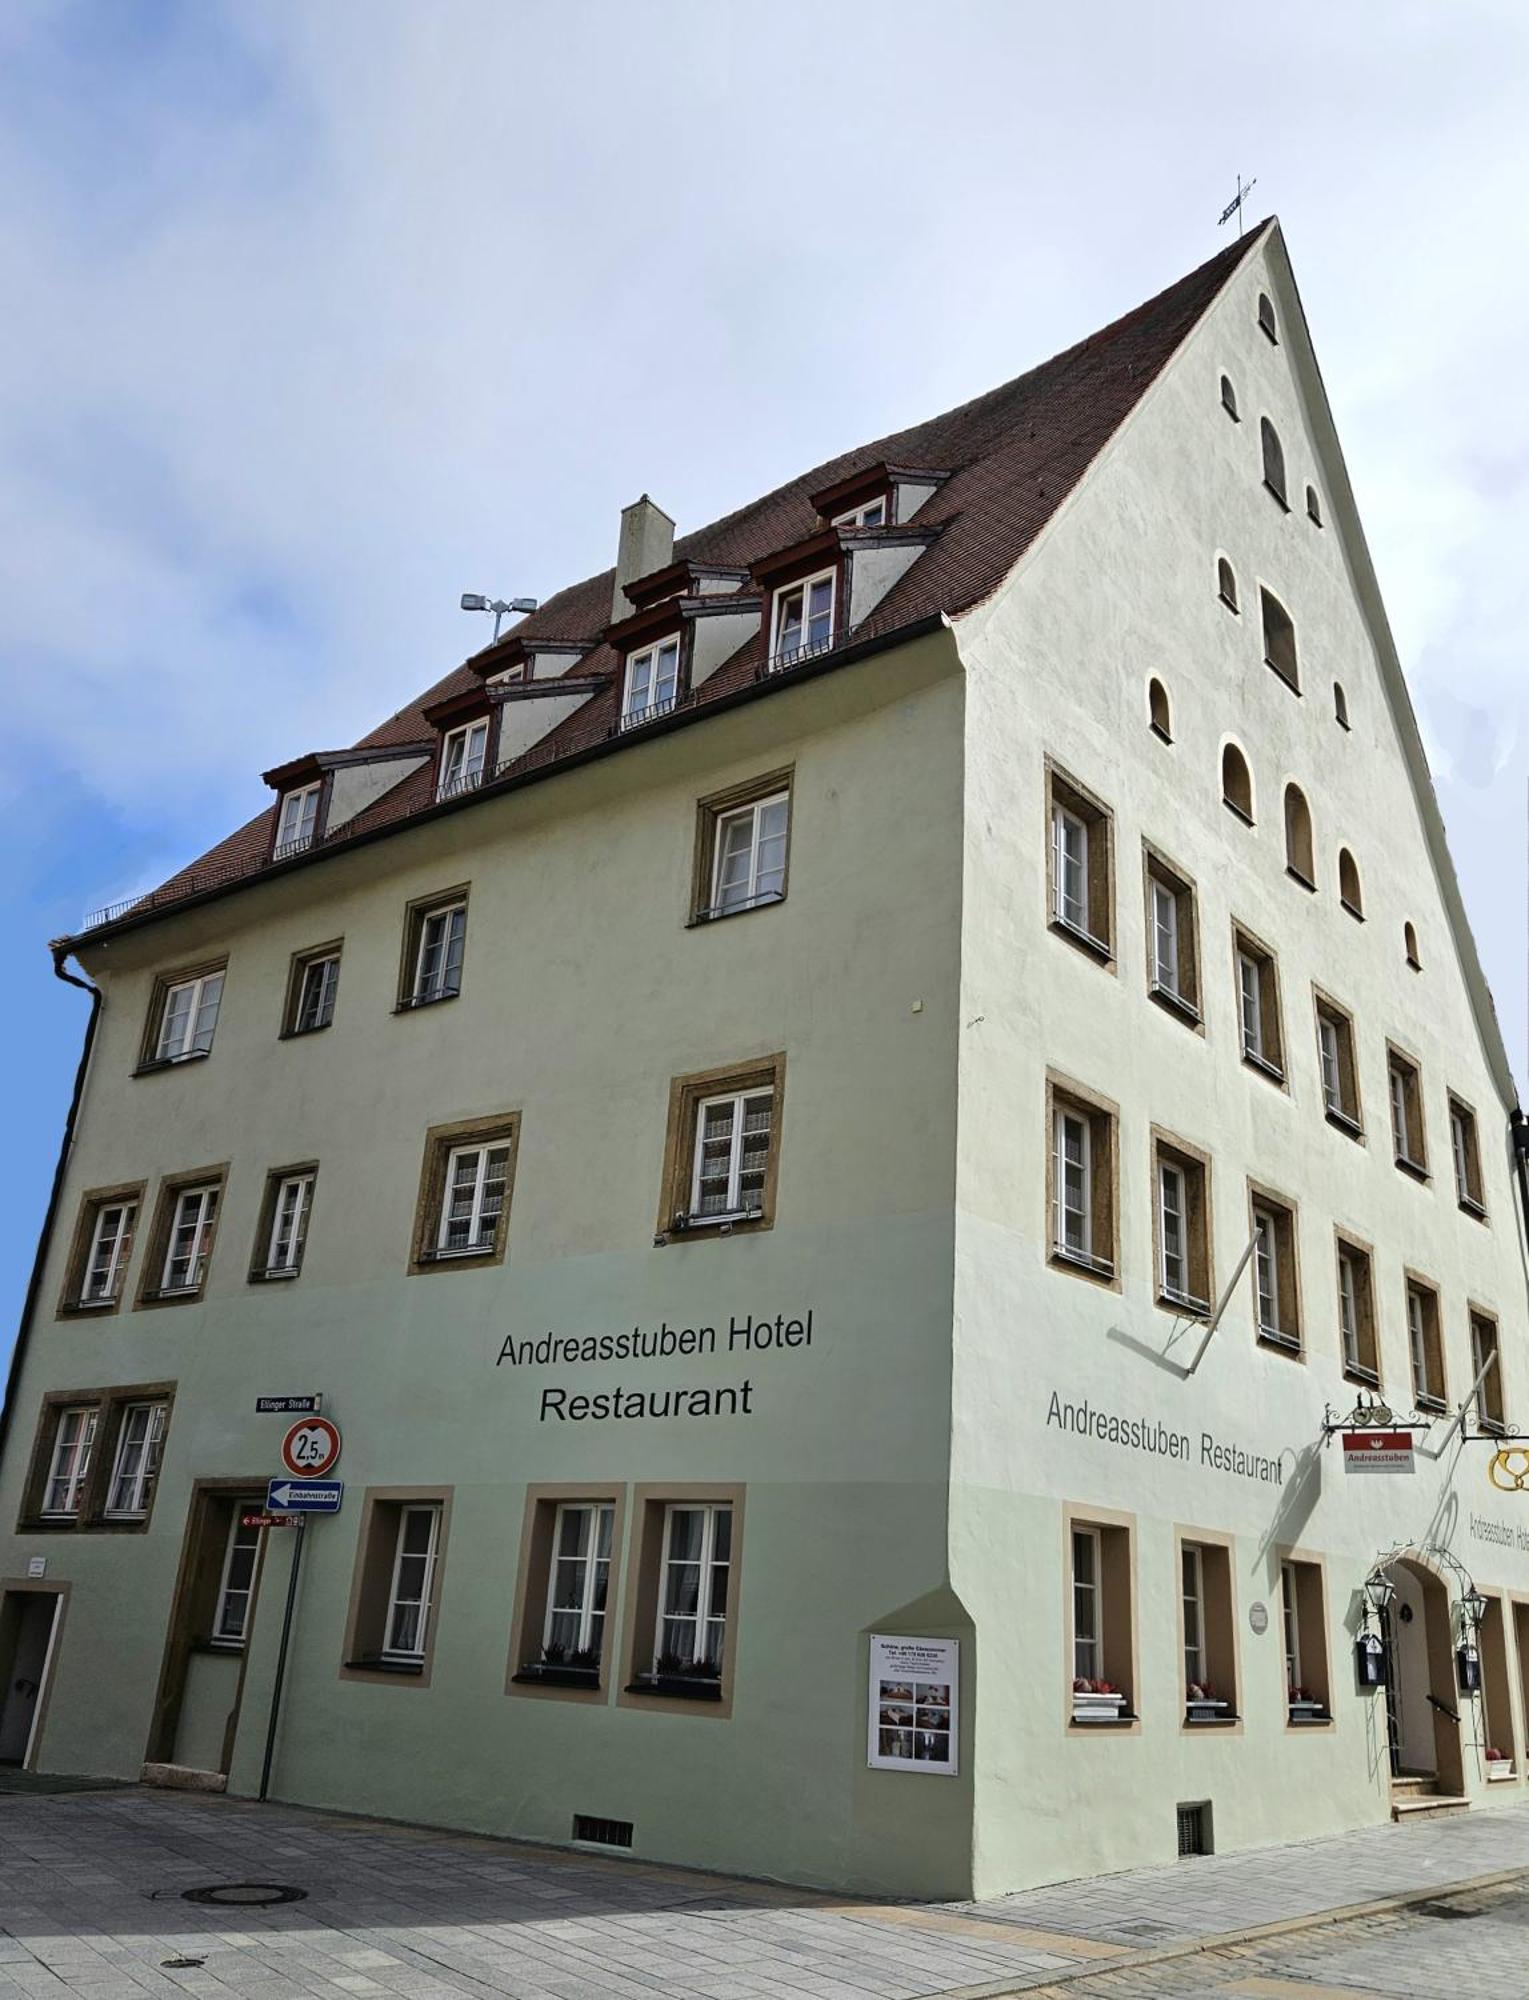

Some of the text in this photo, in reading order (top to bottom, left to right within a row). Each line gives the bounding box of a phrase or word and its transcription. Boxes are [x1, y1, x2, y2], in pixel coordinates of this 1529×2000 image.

[496, 1310, 813, 1367] Andreasstuben Hotel
[260, 1399, 311, 1411] Ellinger Straße
[540, 1379, 753, 1421] Restaurant
[296, 1434, 318, 1460] 2,5
[1047, 1391, 1283, 1486] Andreasstuben Restaurant
[1348, 1452, 1410, 1462] Andreasstuben
[288, 1491, 336, 1500] Einbahnstraße
